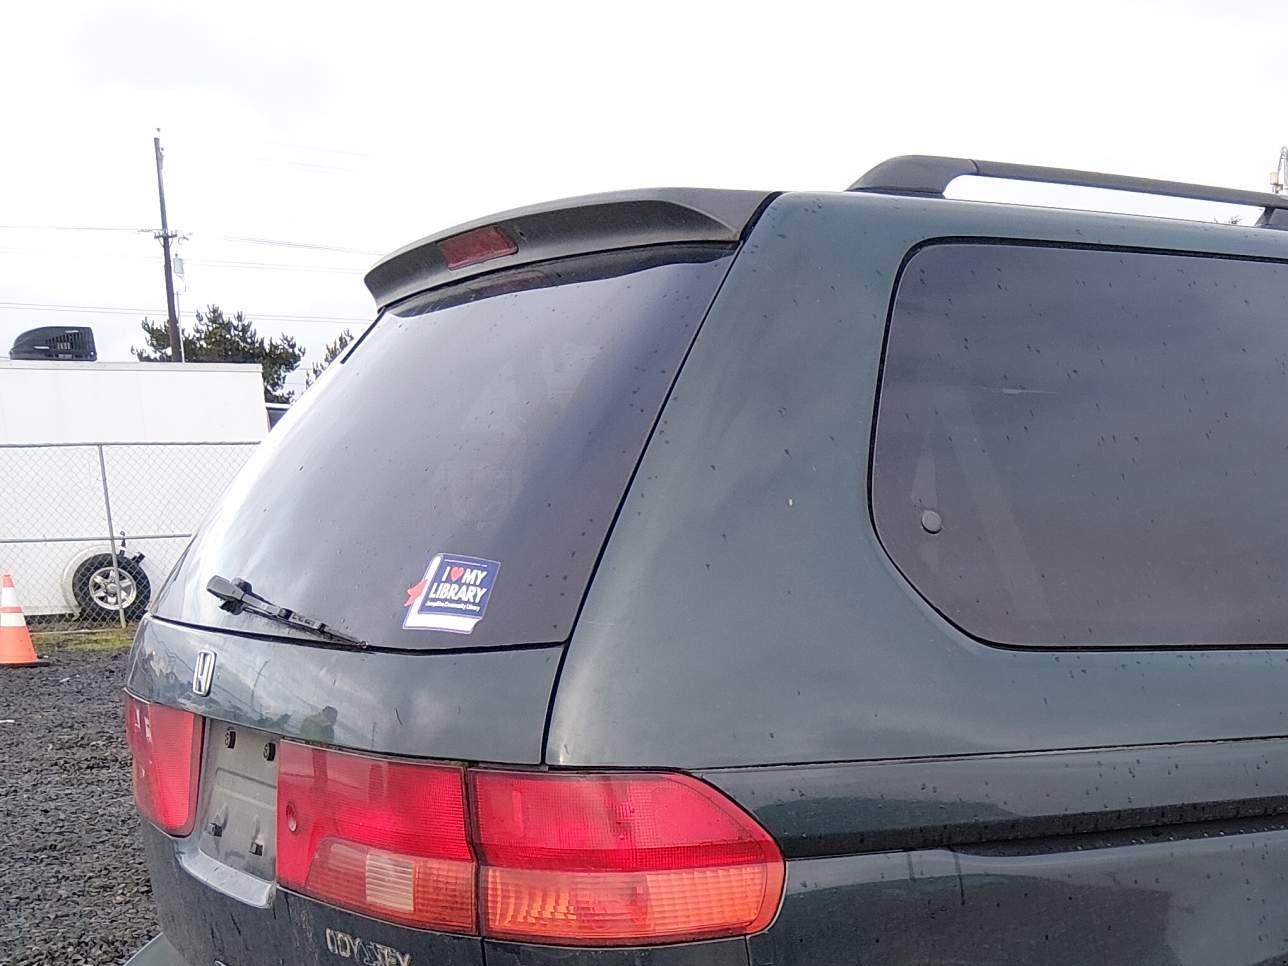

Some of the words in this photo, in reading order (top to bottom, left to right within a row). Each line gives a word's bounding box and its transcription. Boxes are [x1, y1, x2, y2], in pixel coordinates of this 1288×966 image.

[441, 566, 451, 582] I
[461, 568, 488, 586] MY
[428, 582, 488, 603] LIBRARY
